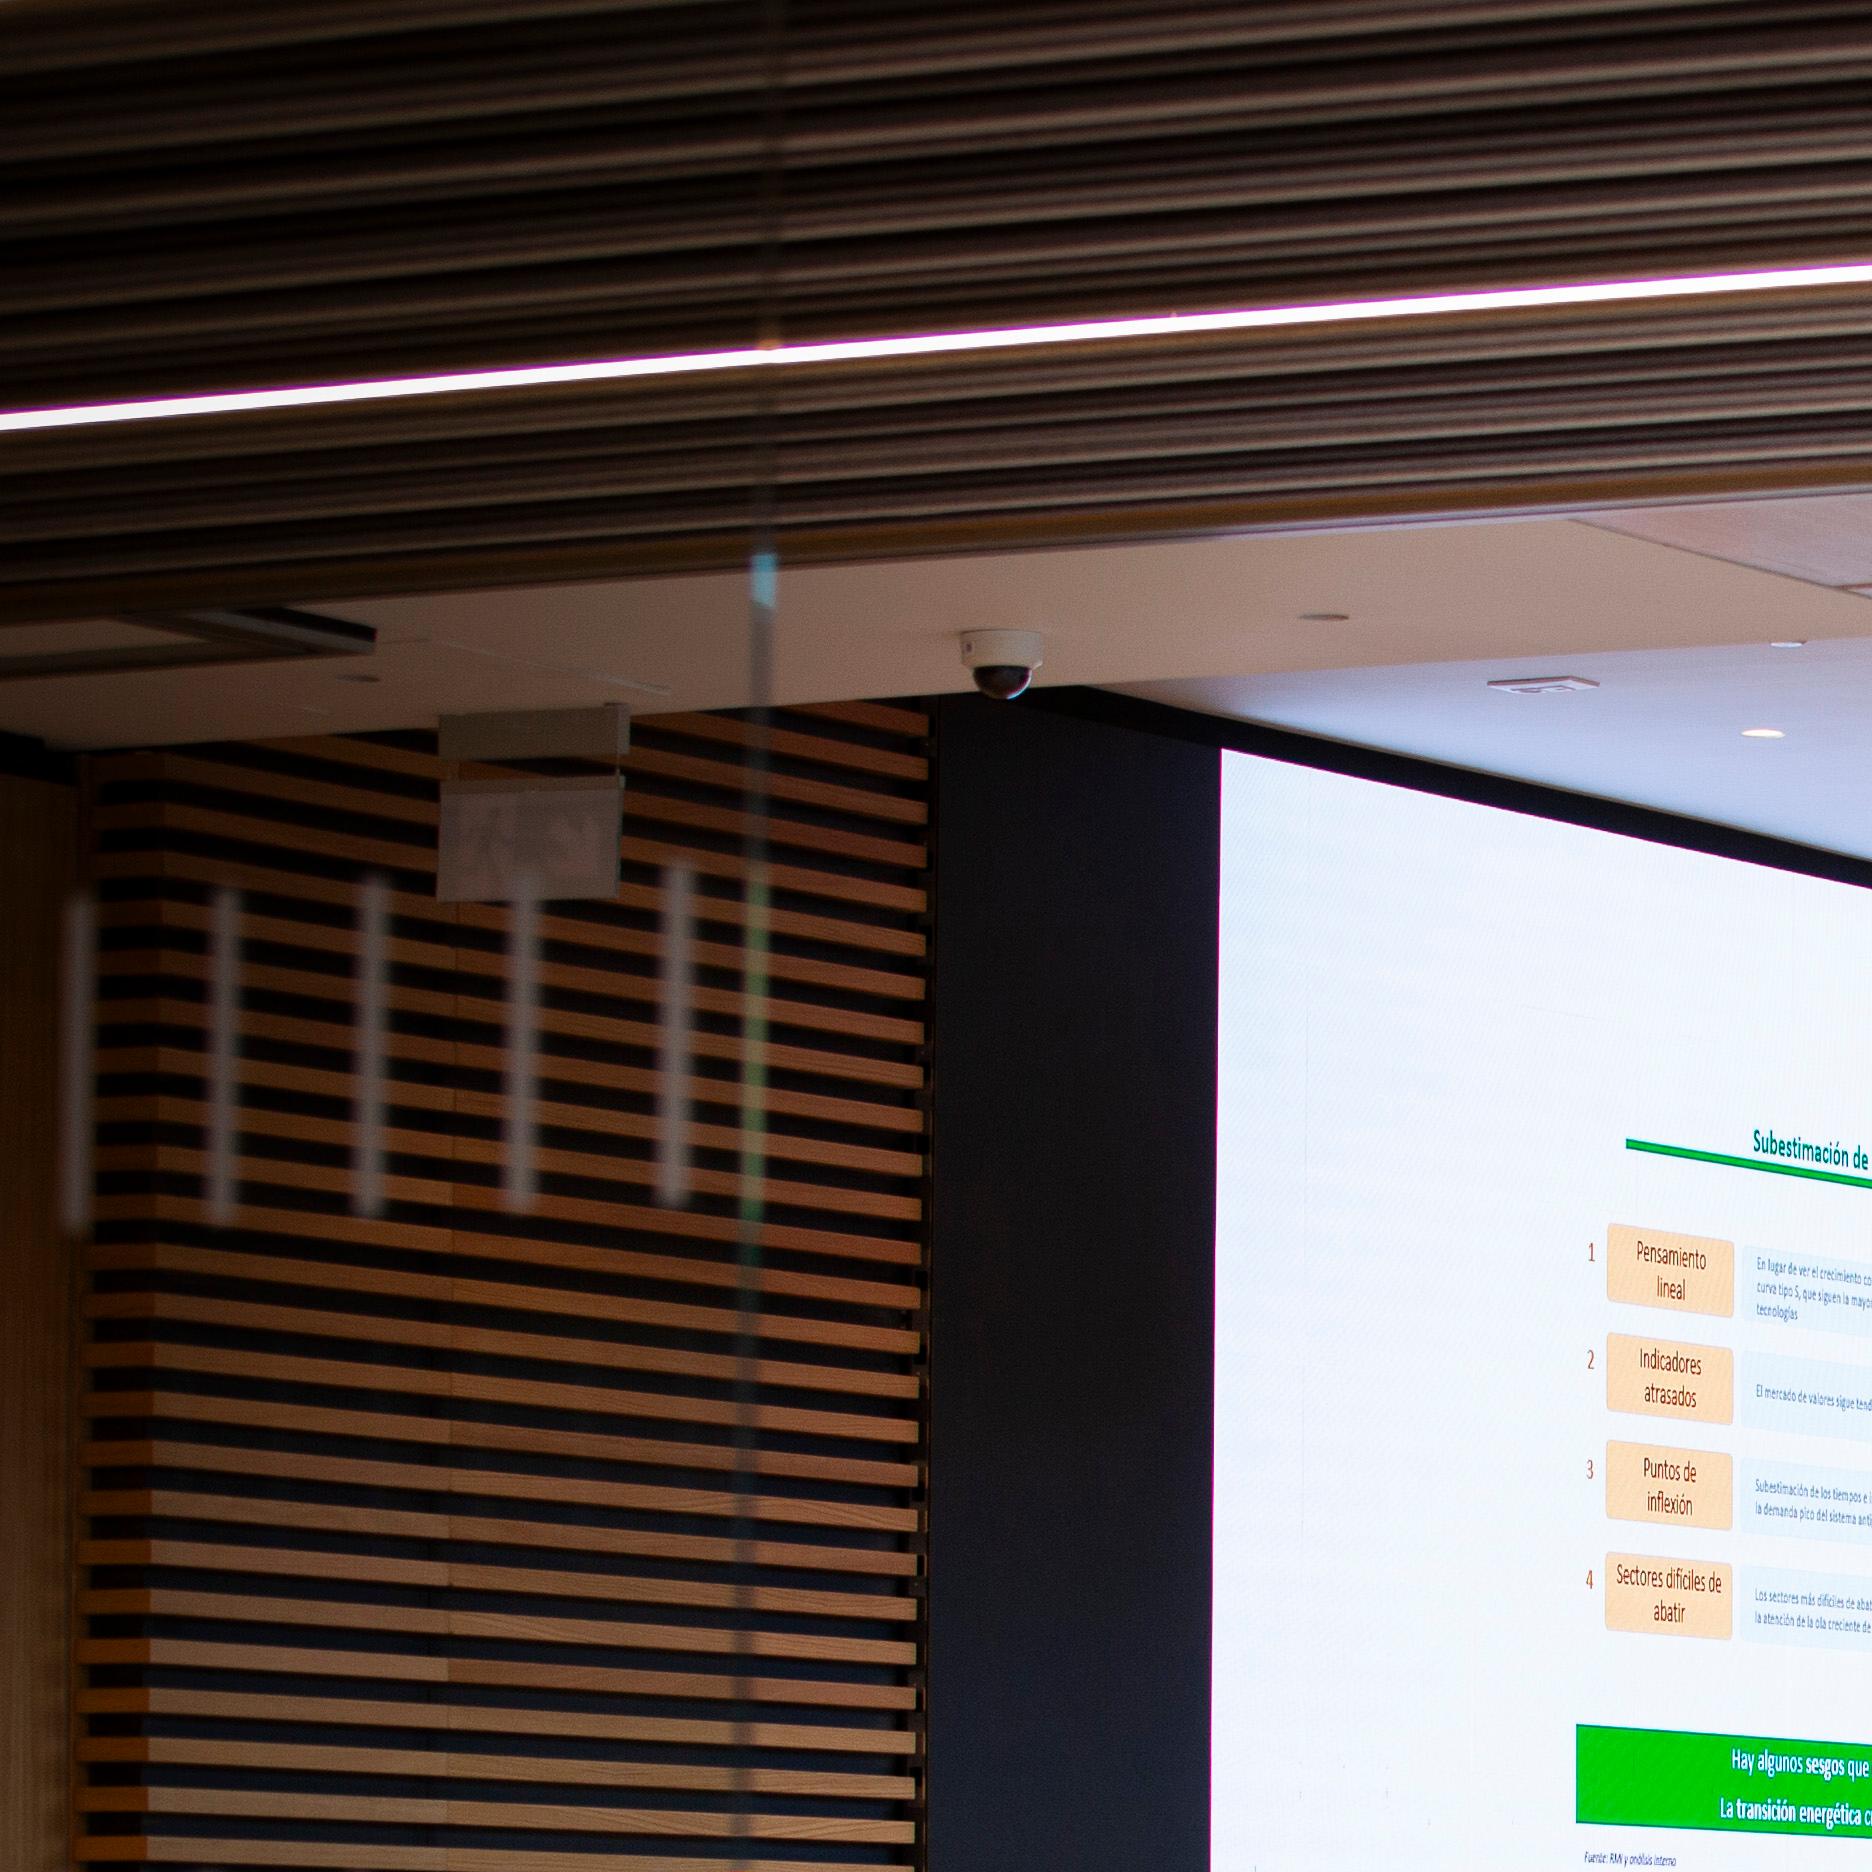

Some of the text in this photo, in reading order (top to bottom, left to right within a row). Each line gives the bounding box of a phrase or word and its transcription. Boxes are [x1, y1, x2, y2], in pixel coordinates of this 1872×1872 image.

[1752, 1128, 1849, 1167] Subestimación
[1852, 1144, 1869, 1171] de
[1587, 1241, 1596, 1262] 1
[1636, 1239, 1707, 1270] Pensamiento
[1656, 1274, 1686, 1301] lineal
[1586, 1348, 1595, 1370] 2
[1639, 1346, 1702, 1376] Indicadores
[1643, 1383, 1697, 1408] atrasados
[1586, 1458, 1594, 1480] 3
[1643, 1456, 1697, 1483] Puntos de
[1646, 1489, 1693, 1516] inflexión
[1585, 1569, 1594, 1590] 4
[1615, 1563, 1722, 1594] Sectores difíciles de
[1653, 1598, 1686, 1623] abatir
[1731, 1748, 1755, 1776] Hay
[1756, 1748, 1803, 1777] algunos
[1804, 1756, 1845, 1781] sesgos
[1846, 1759, 1870, 1782] que
[1719, 1797, 1734, 1818] La
[1735, 1797, 1796, 1822] transición
[1798, 1802, 1862, 1830] energética
